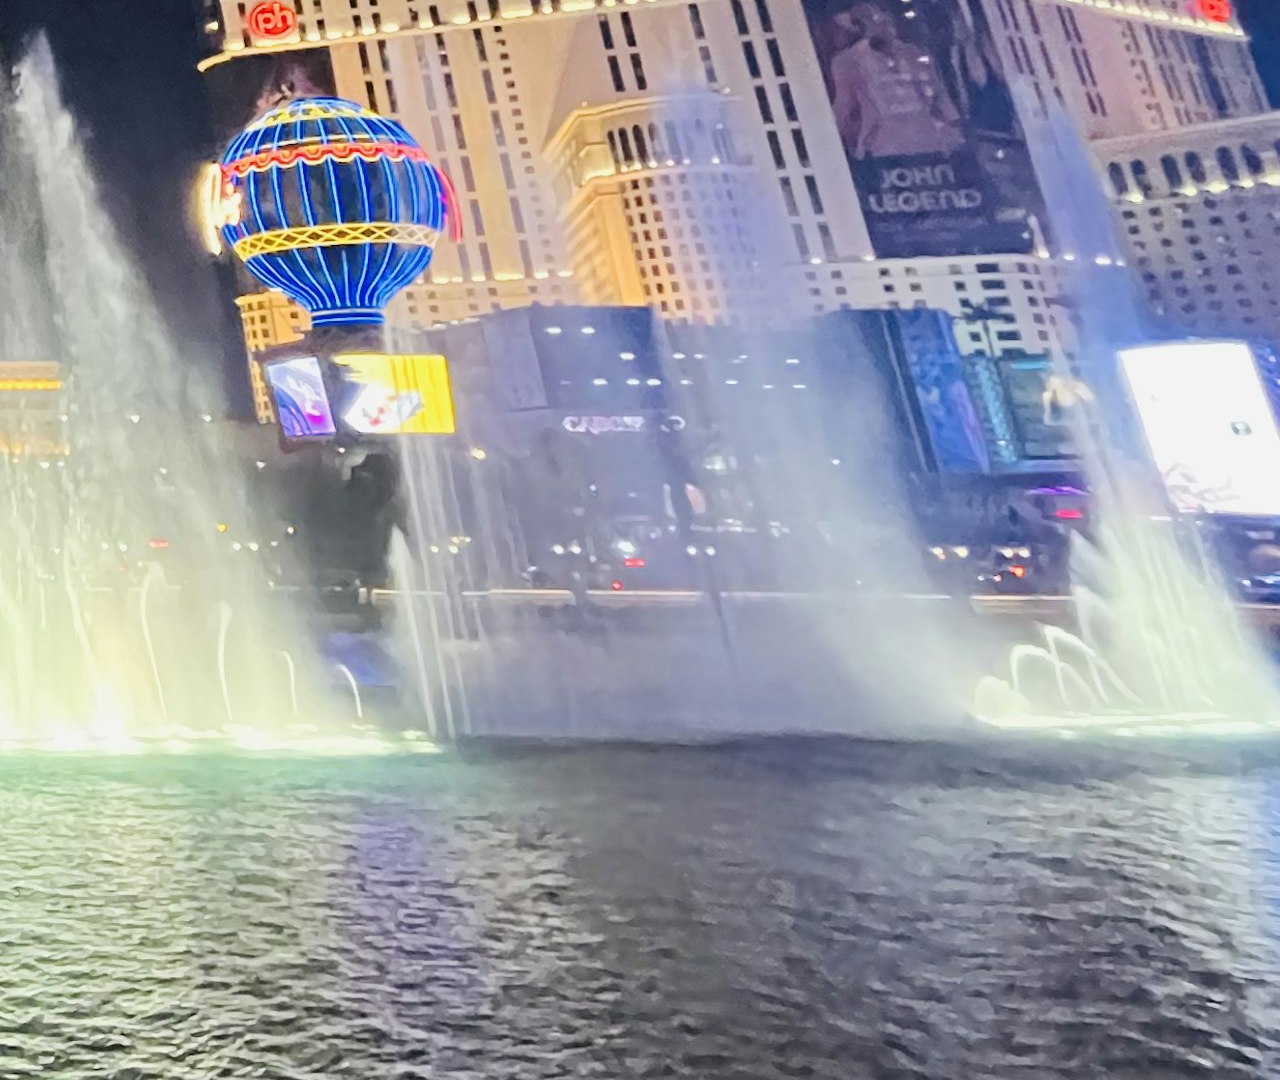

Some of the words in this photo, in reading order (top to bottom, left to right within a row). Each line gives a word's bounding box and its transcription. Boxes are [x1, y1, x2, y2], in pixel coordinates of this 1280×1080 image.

[256, 2, 294, 34] ph
[880, 164, 956, 188] JOHN
[868, 188, 983, 213] LEGEND
